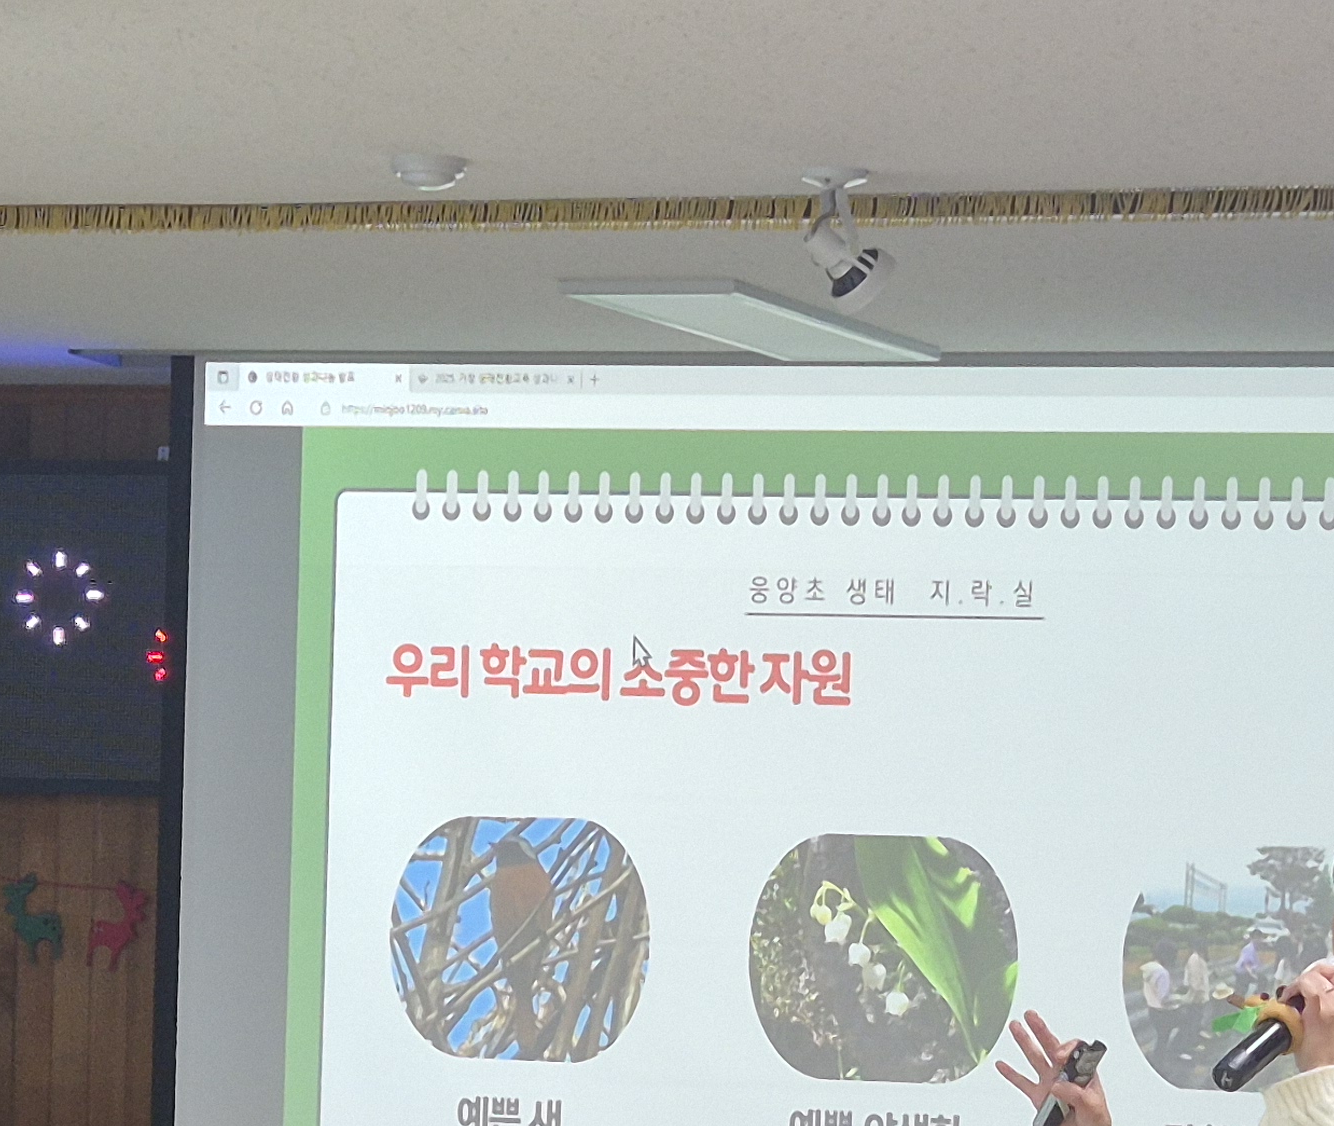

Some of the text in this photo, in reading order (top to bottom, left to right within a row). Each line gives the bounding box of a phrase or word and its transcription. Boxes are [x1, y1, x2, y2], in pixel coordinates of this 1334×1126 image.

[750, 576, 825, 604] 웅양초
[847, 579, 894, 605] 생태
[385, 641, 854, 707] 우리 학교의 소중한 자원
